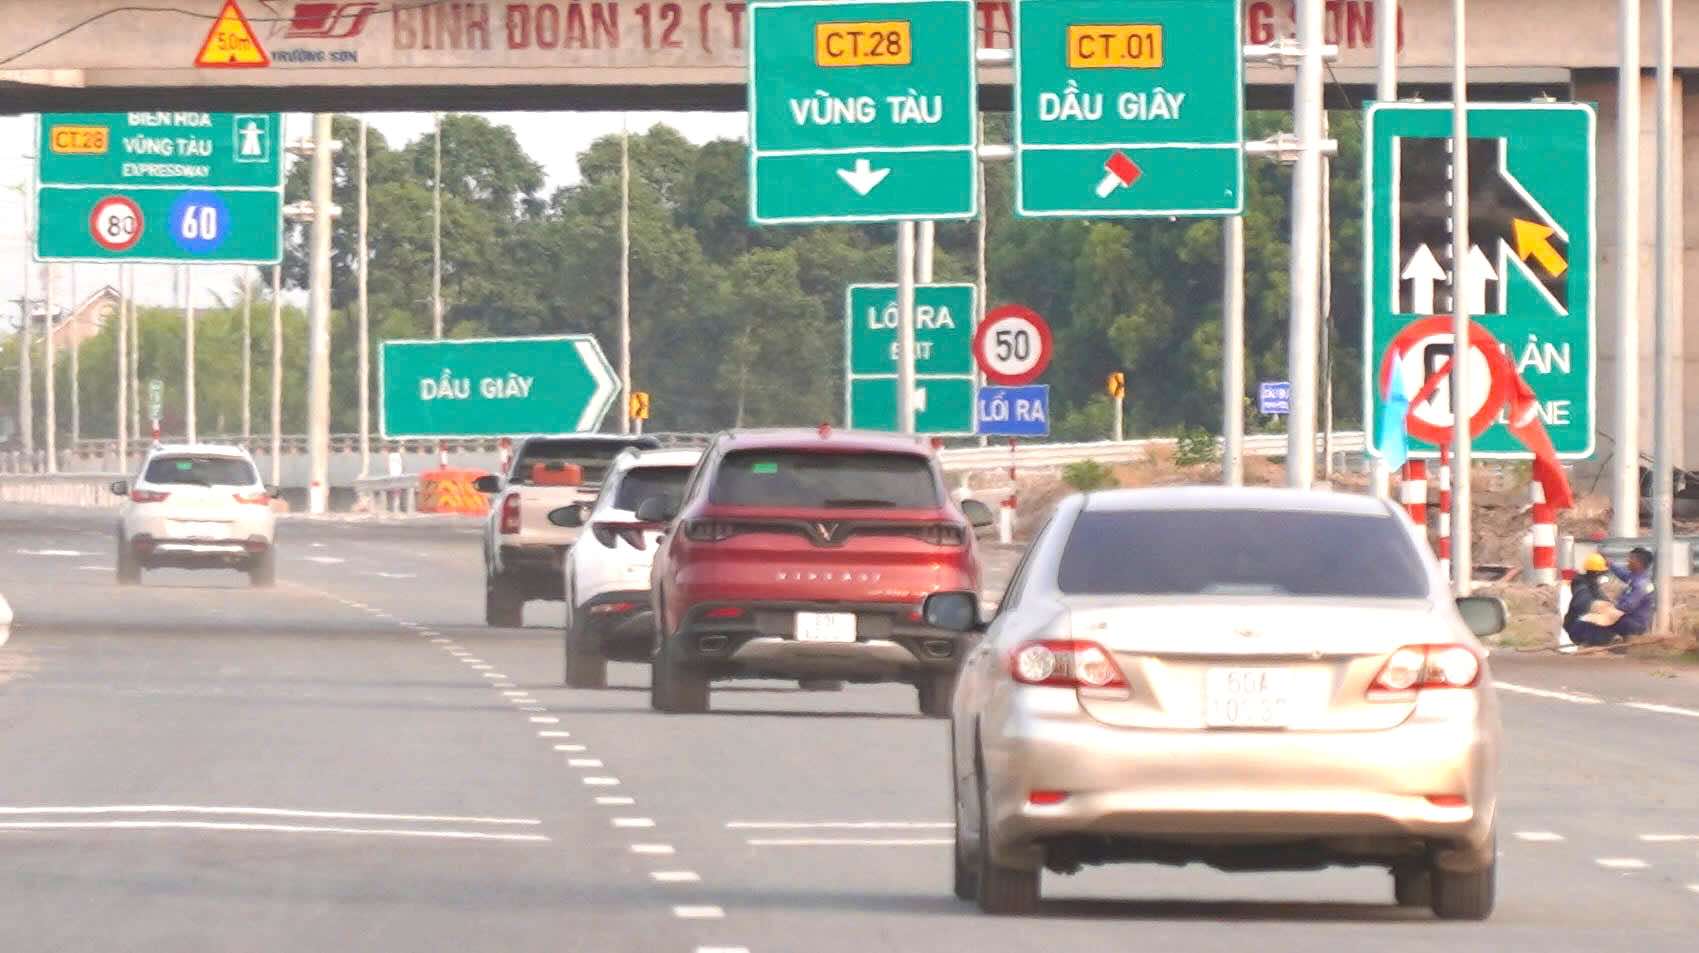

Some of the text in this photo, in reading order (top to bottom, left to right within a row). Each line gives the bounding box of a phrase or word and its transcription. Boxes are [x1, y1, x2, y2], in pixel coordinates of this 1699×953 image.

[635, 3, 683, 49] 12
[826, 32, 902, 57] CT.28
[1078, 33, 1154, 59] CT.01
[789, 88, 943, 125] VŨNG TÀU
[1039, 79, 1104, 121] DẦU
[122, 133, 213, 156] VŨNG TÀU
[107, 215, 135, 236] 80
[181, 206, 217, 240] 60
[917, 304, 955, 329] RA
[890, 341, 934, 360] EIT
[996, 330, 1029, 362] 50
[981, 391, 1045, 422] LỐI RA
